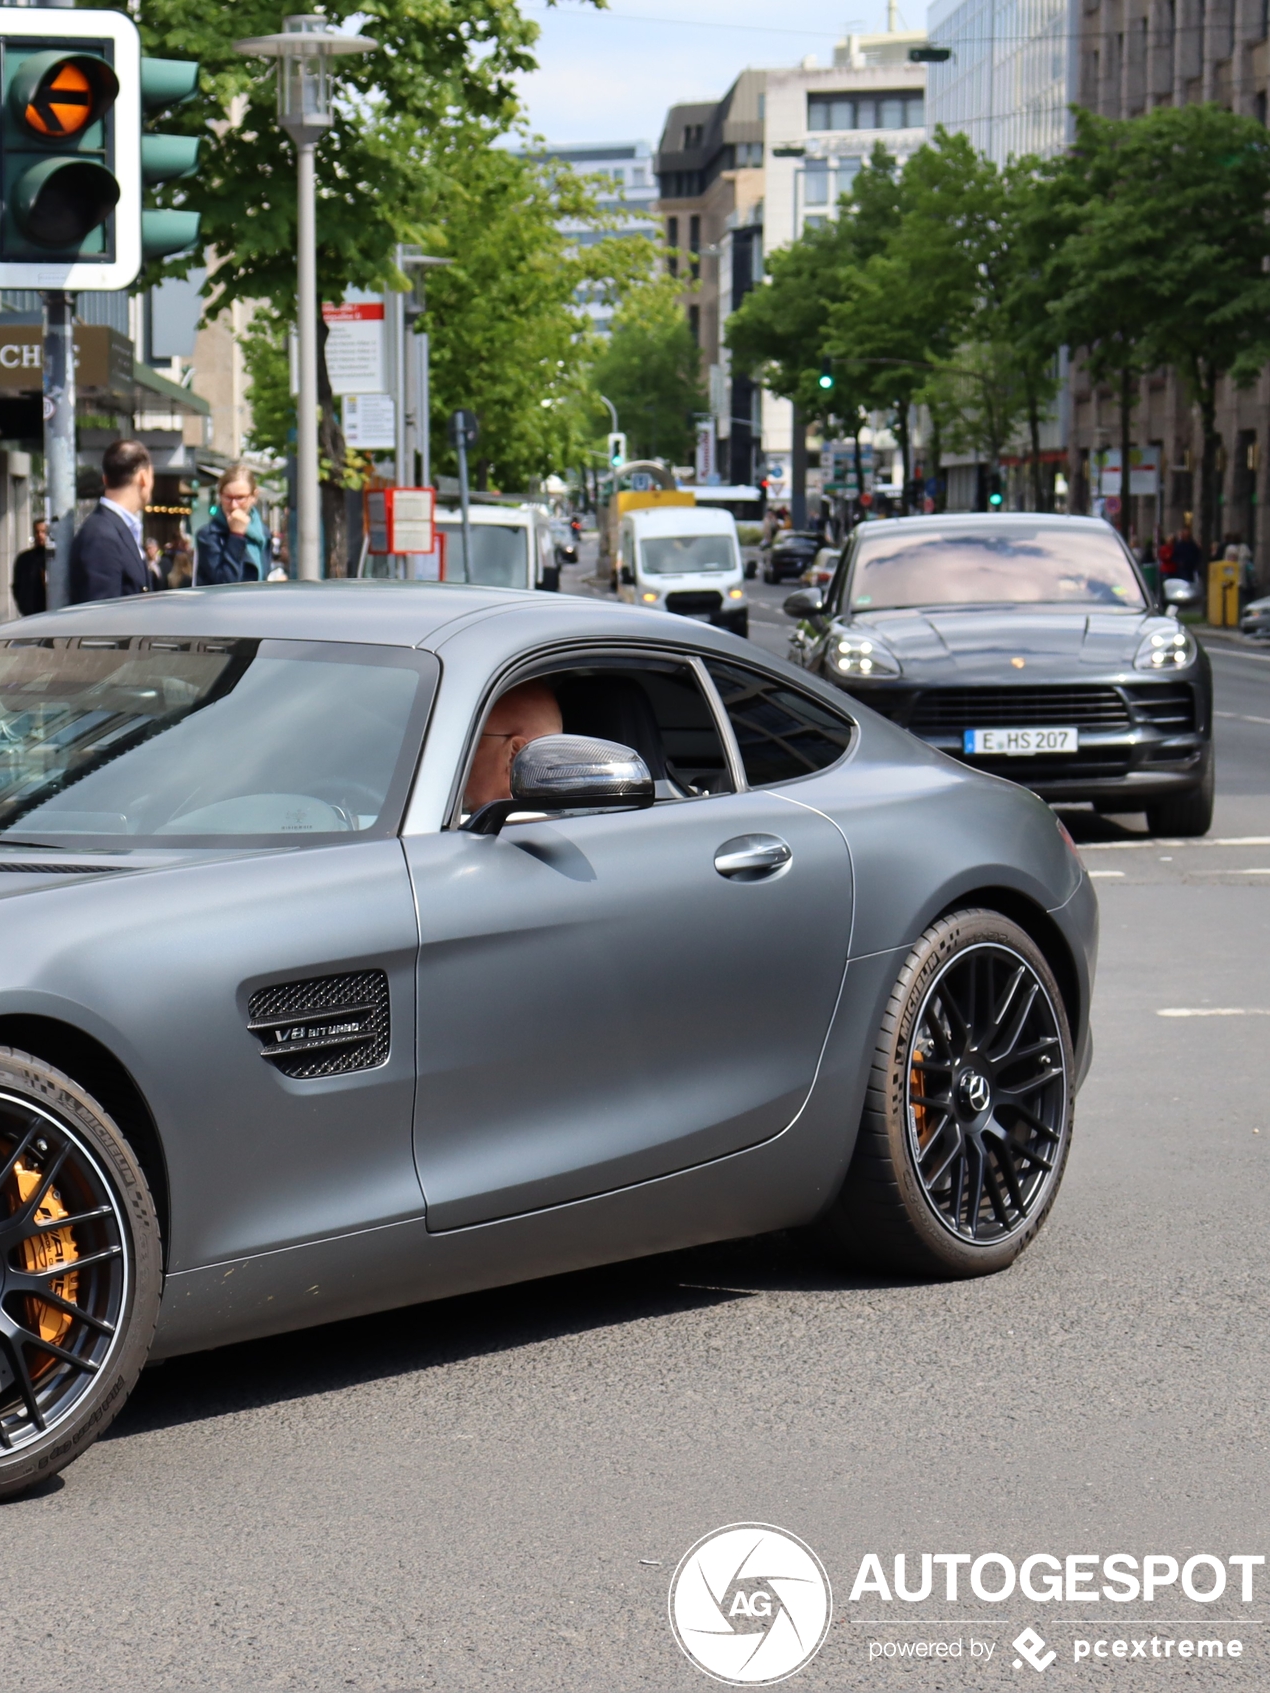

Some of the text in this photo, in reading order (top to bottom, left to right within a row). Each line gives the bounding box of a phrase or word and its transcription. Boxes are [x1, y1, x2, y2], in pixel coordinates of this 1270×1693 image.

[983, 732, 1069, 750] E HS 207
[900, 952, 940, 1040] MICHELIN
[275, 1022, 359, 1043] V8 BITURBO
[77, 1106, 136, 1184] MICHELIN
